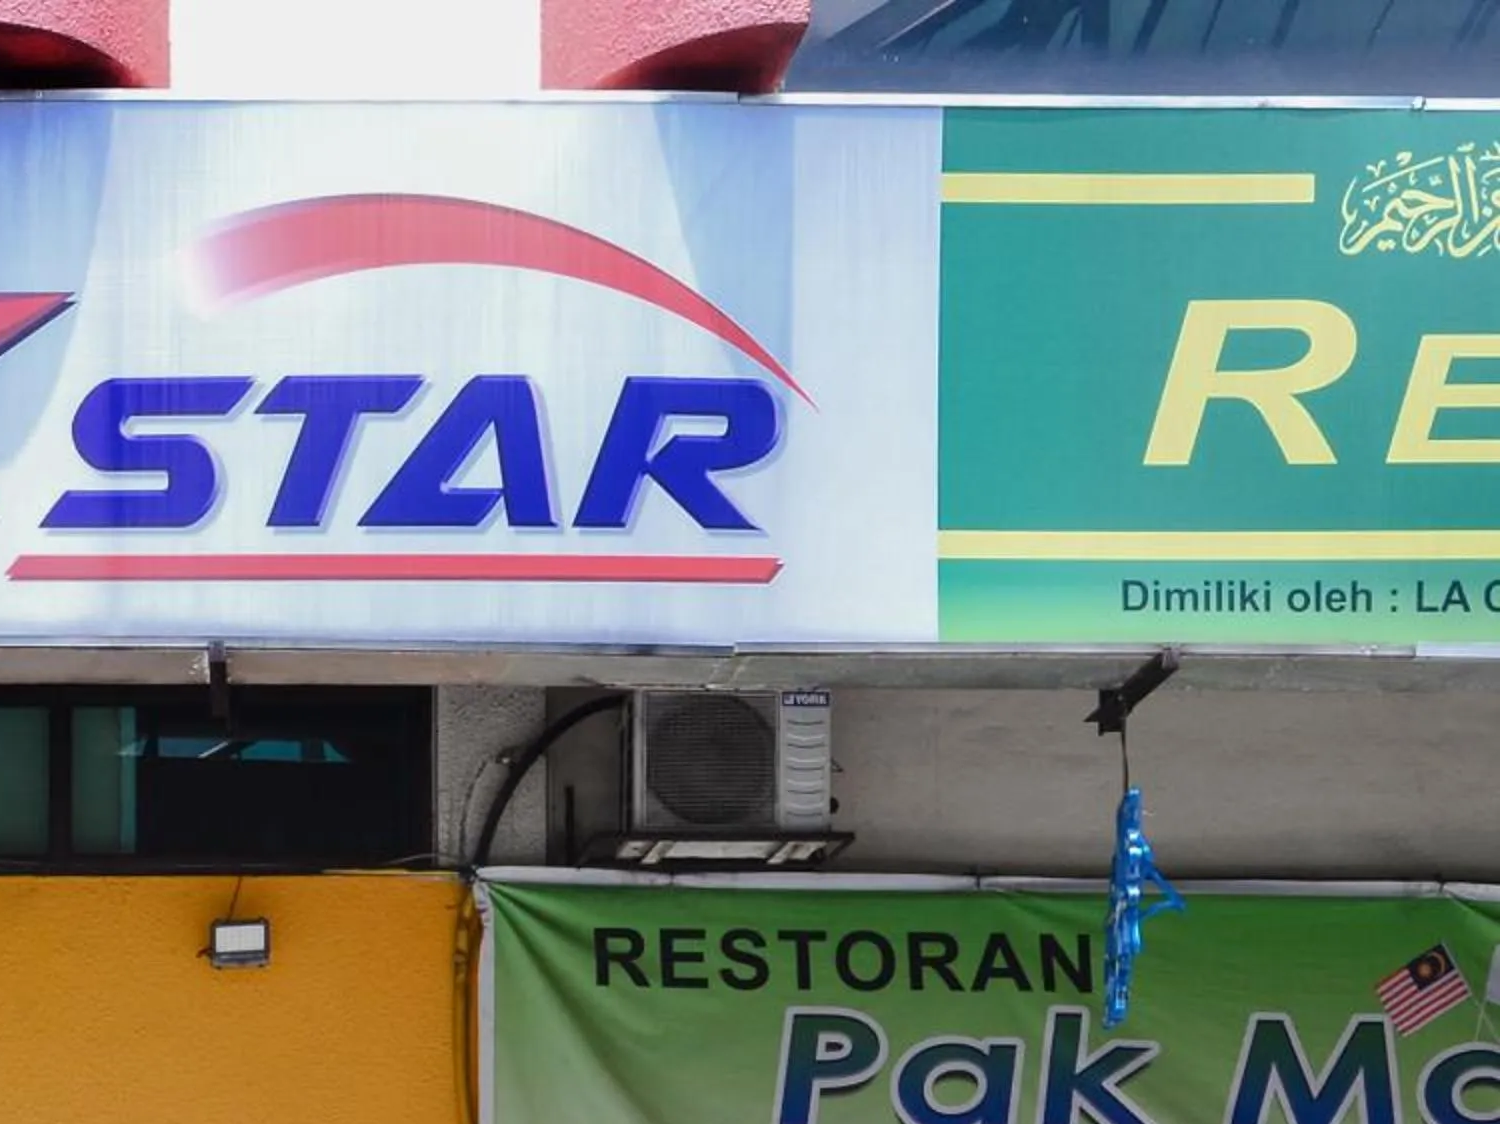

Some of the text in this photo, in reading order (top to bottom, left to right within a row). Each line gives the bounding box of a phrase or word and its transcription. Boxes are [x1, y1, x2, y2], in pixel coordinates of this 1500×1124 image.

[38, 374, 786, 534] STAR
[1121, 579, 1272, 613] Dimiliki
[1287, 579, 1373, 613] oleh
[1415, 580, 1471, 613] LA
[593, 927, 1093, 994] RESTORAN
